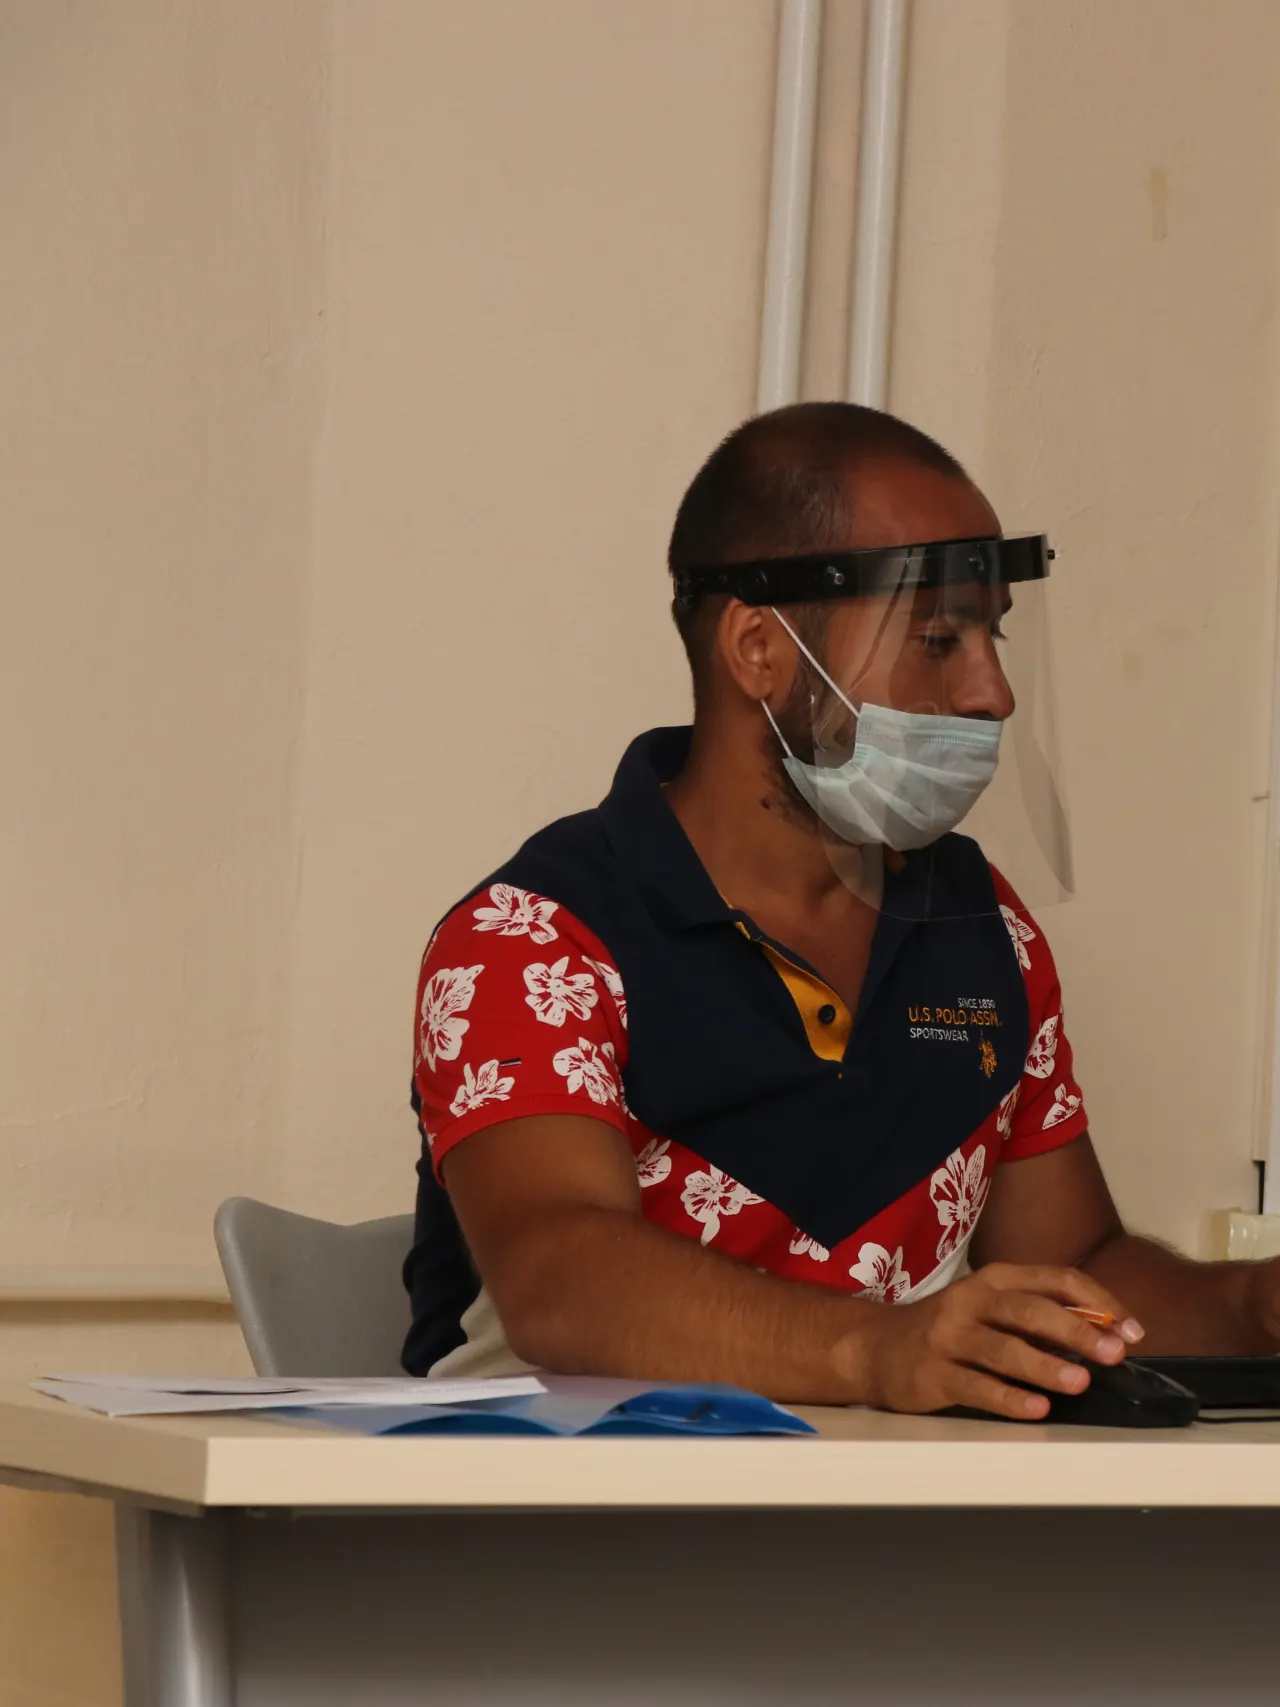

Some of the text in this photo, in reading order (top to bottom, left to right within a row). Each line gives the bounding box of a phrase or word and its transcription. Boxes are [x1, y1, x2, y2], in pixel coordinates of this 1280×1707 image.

[957, 997, 978, 1009] SINCE
[908, 1006, 935, 1022] U.S.
[936, 1007, 967, 1025] POLO
[910, 1027, 969, 1042] SPORTSWEAR
